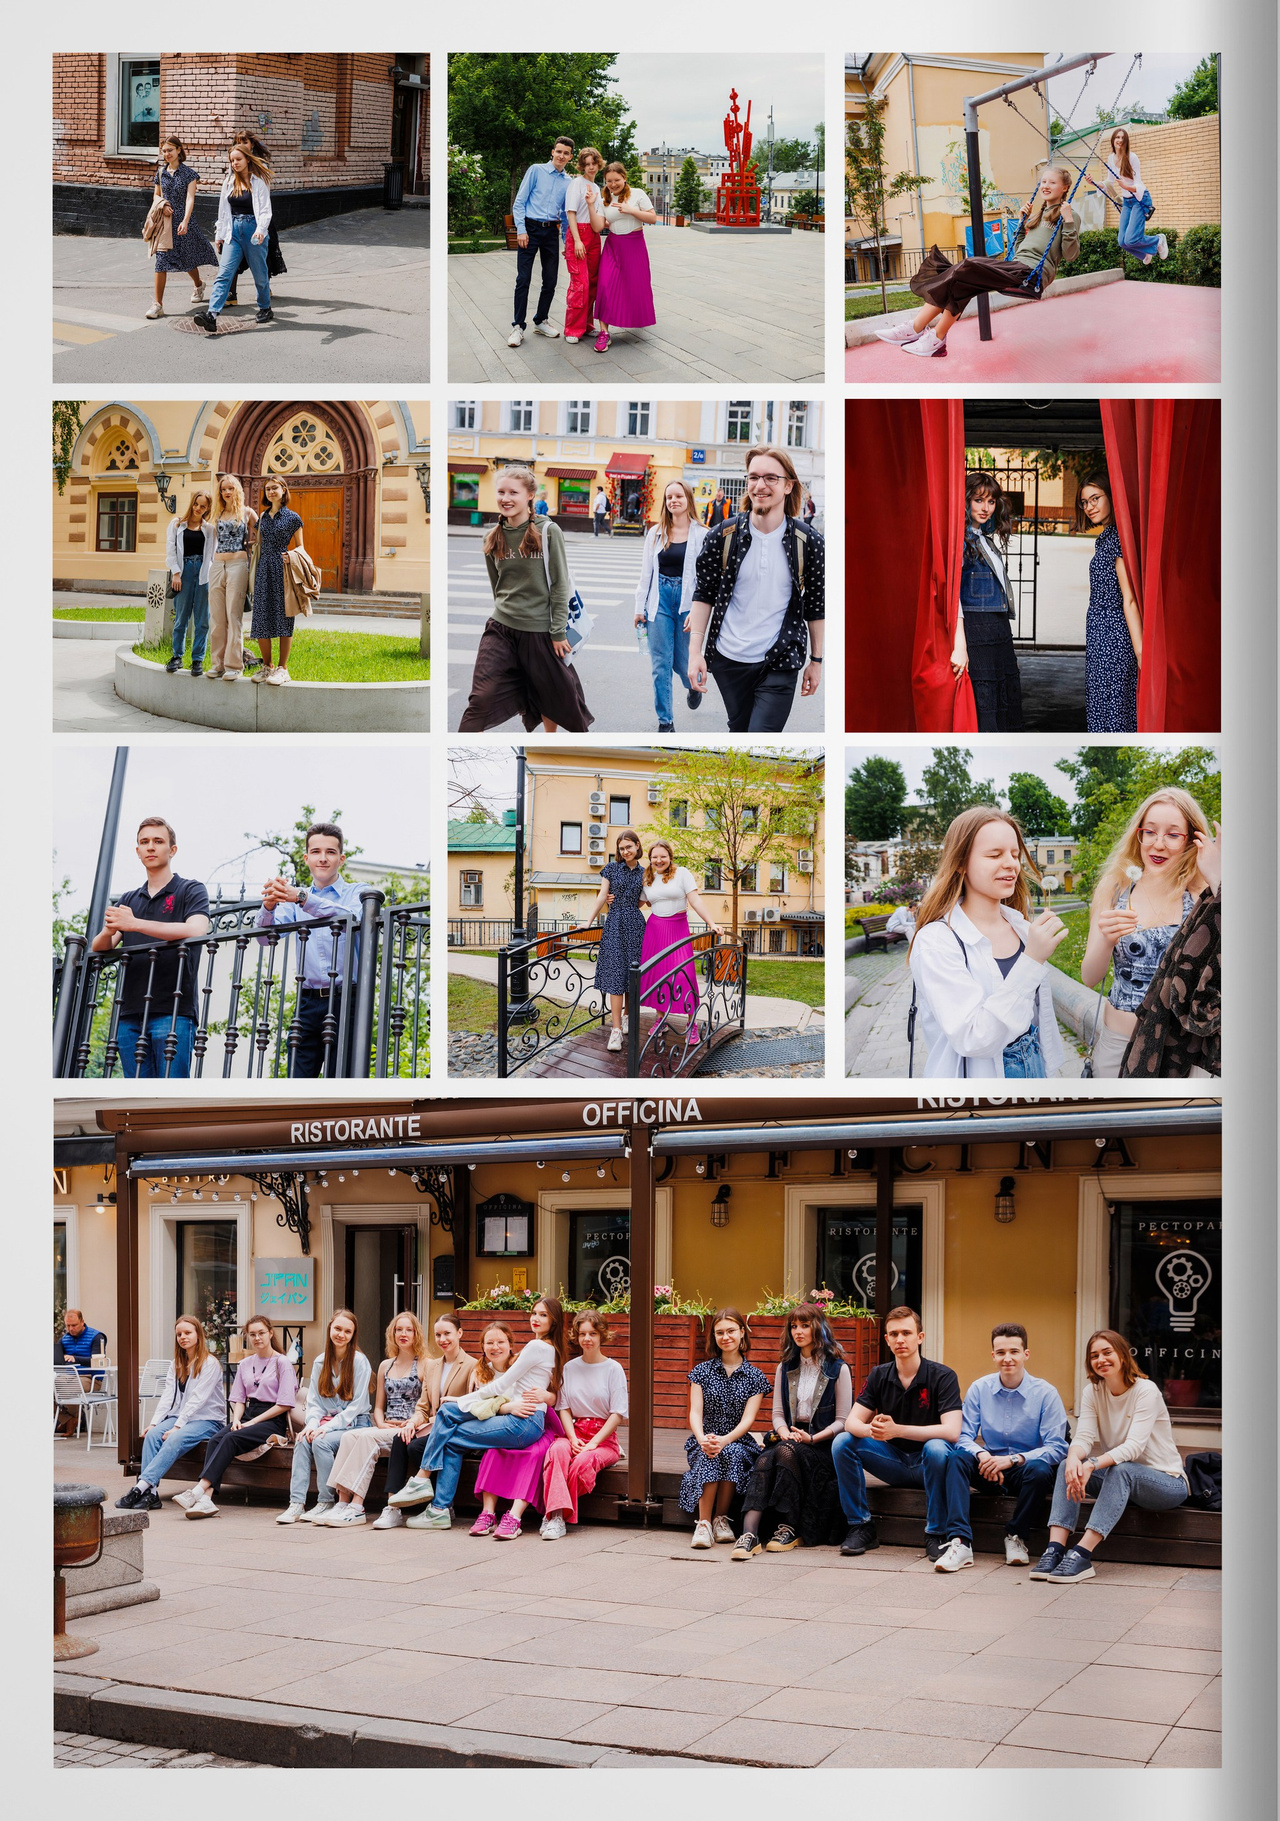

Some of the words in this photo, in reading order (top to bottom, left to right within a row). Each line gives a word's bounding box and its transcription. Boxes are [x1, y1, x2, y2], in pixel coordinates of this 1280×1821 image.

[582, 1099, 703, 1126] OFFICINA
[291, 1115, 421, 1143] RISTORANTE
[586, 1232, 630, 1241] РЕСТОР
[829, 1227, 918, 1236] RISTONTE
[260, 1292, 307, 1304] ジェイパン
